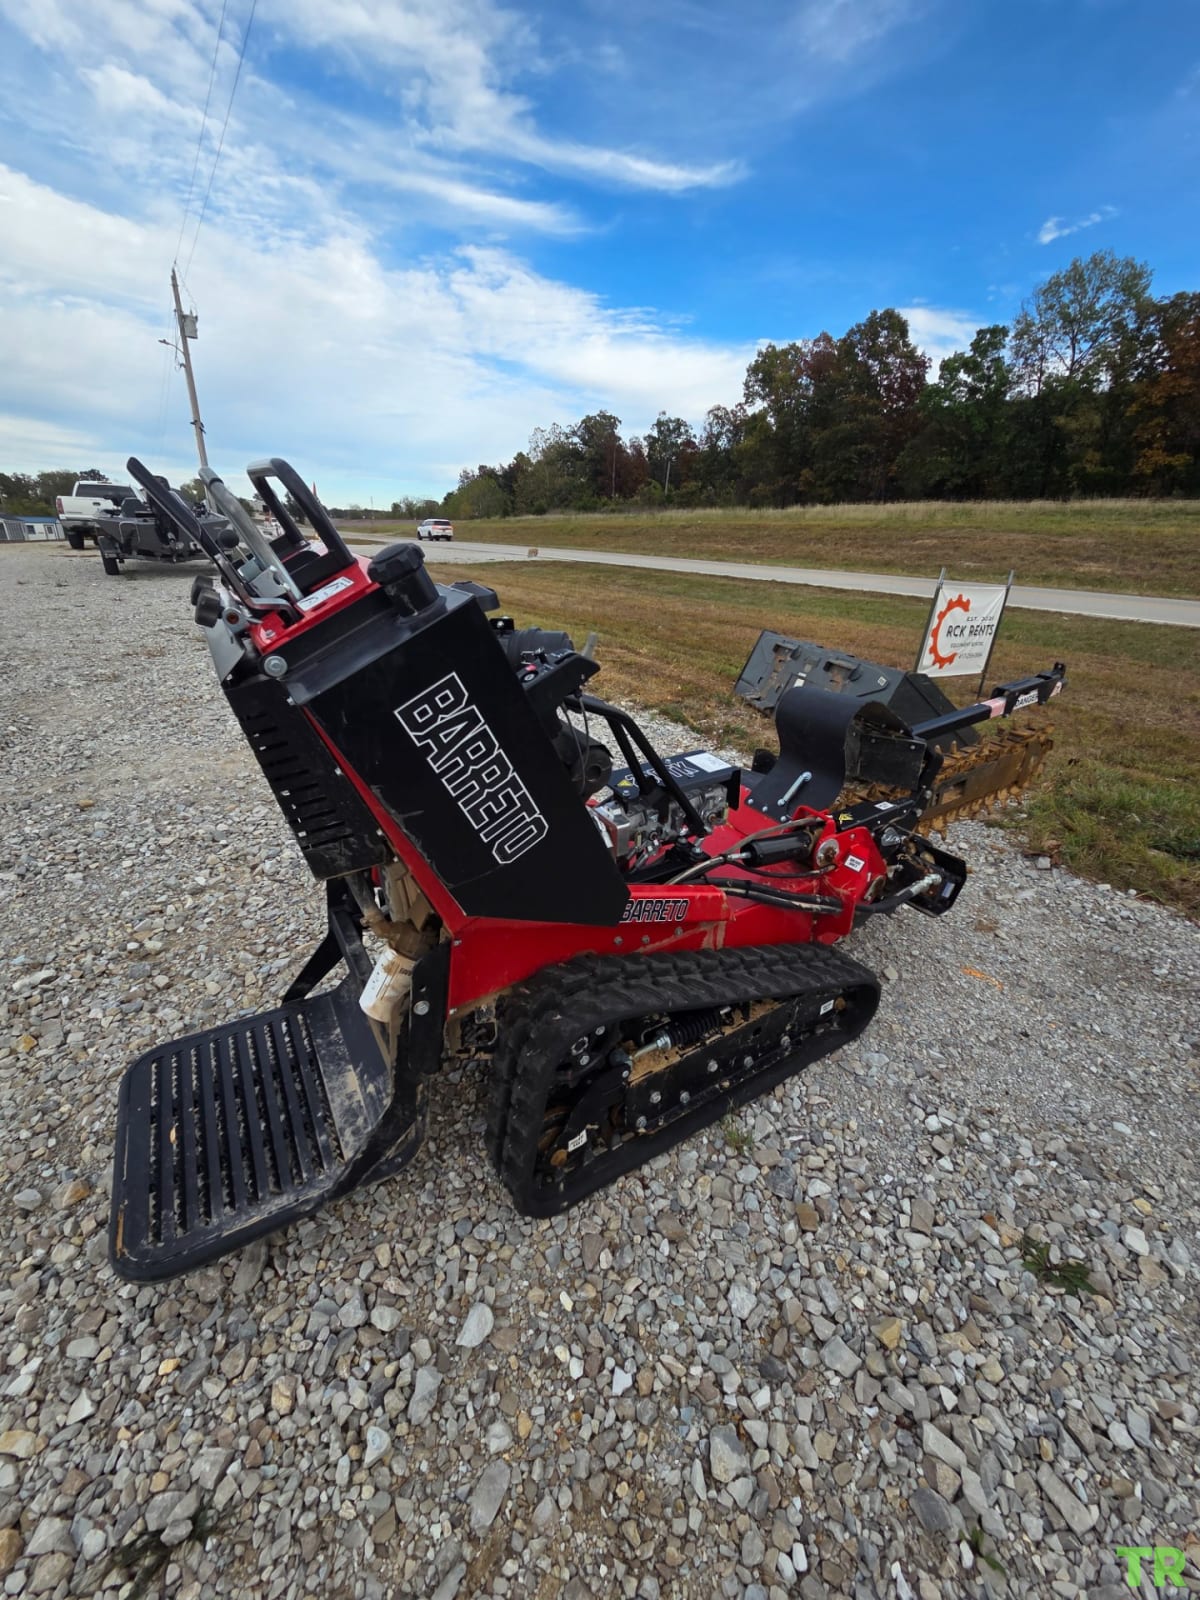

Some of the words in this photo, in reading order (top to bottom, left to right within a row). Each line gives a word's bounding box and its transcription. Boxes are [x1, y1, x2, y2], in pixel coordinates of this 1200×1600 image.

[946, 624, 967, 638] RCK
[968, 624, 995, 637] RENTS
[394, 671, 549, 864] BARRETO
[619, 898, 690, 923] BARRETO
